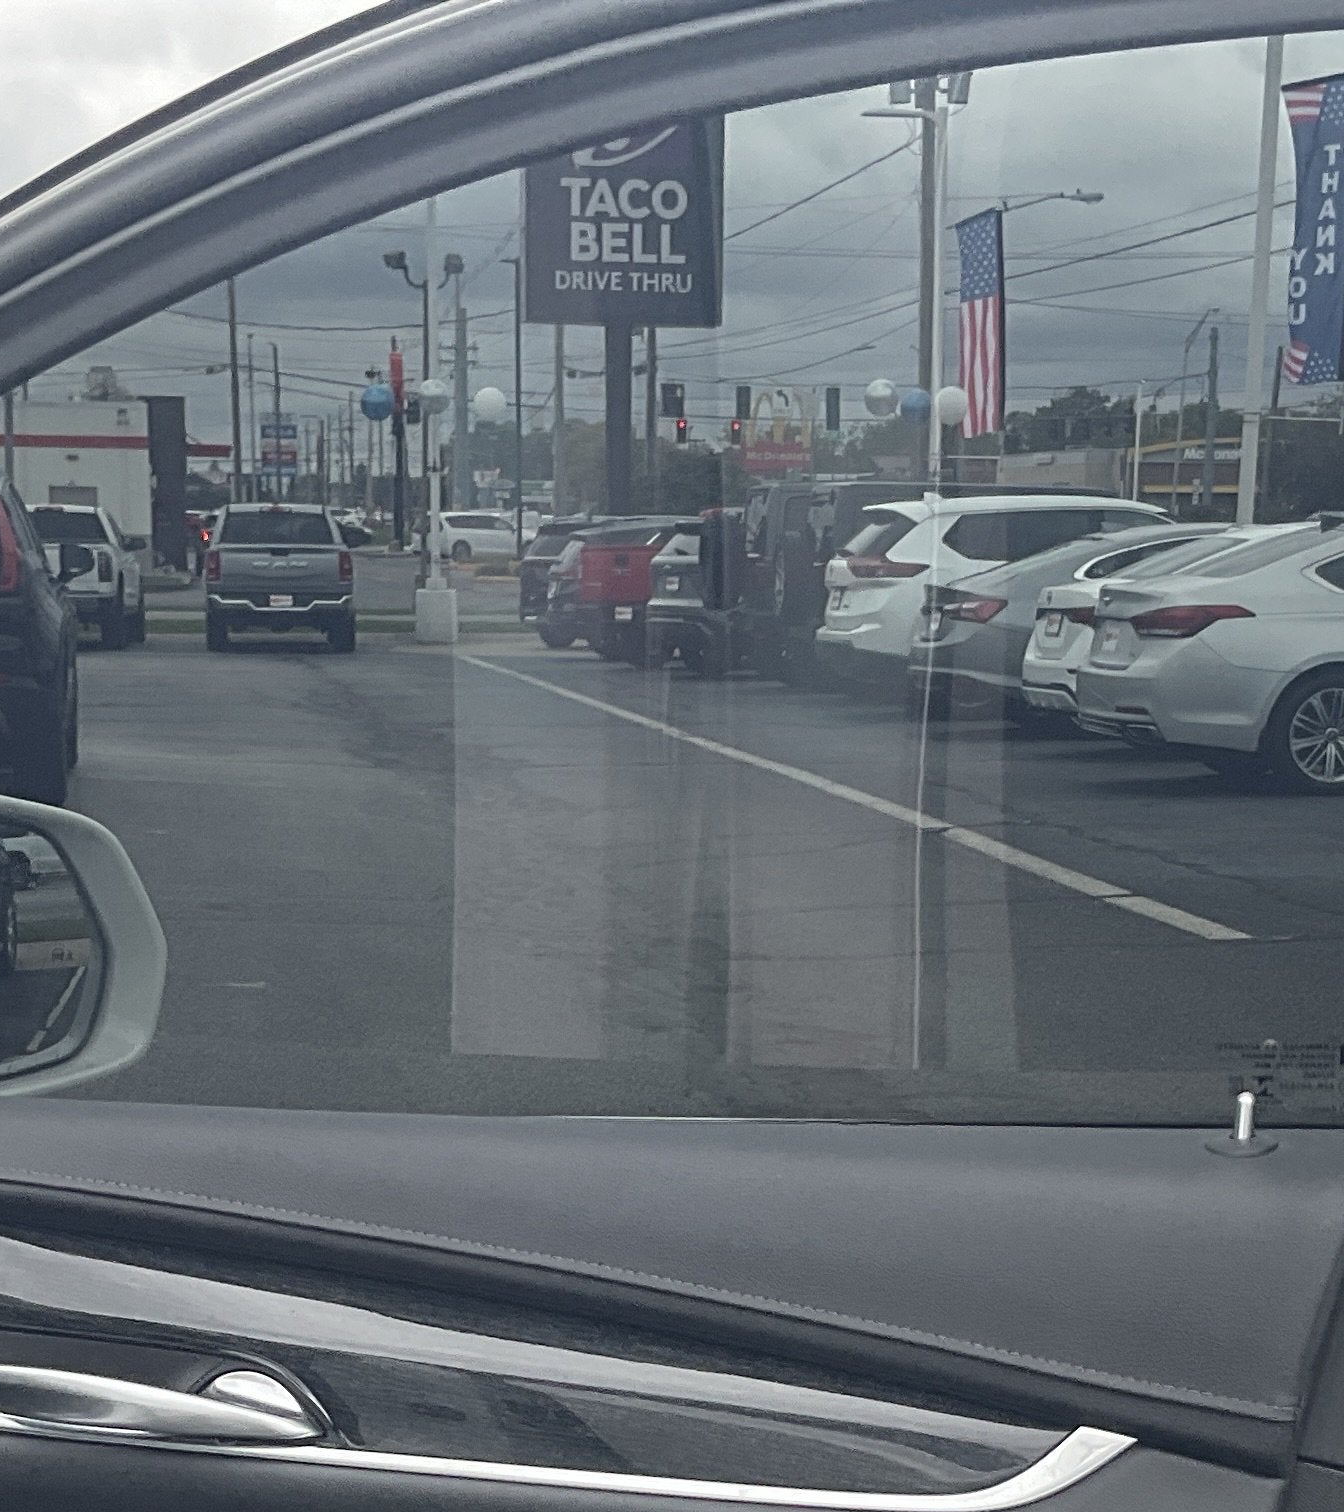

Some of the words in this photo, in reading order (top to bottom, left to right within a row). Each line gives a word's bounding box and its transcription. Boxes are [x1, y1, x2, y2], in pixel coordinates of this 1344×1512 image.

[560, 177, 688, 220] TACO
[570, 221, 687, 264] BELL
[555, 270, 623, 291] DRIVE
[628, 272, 693, 293] THRU
